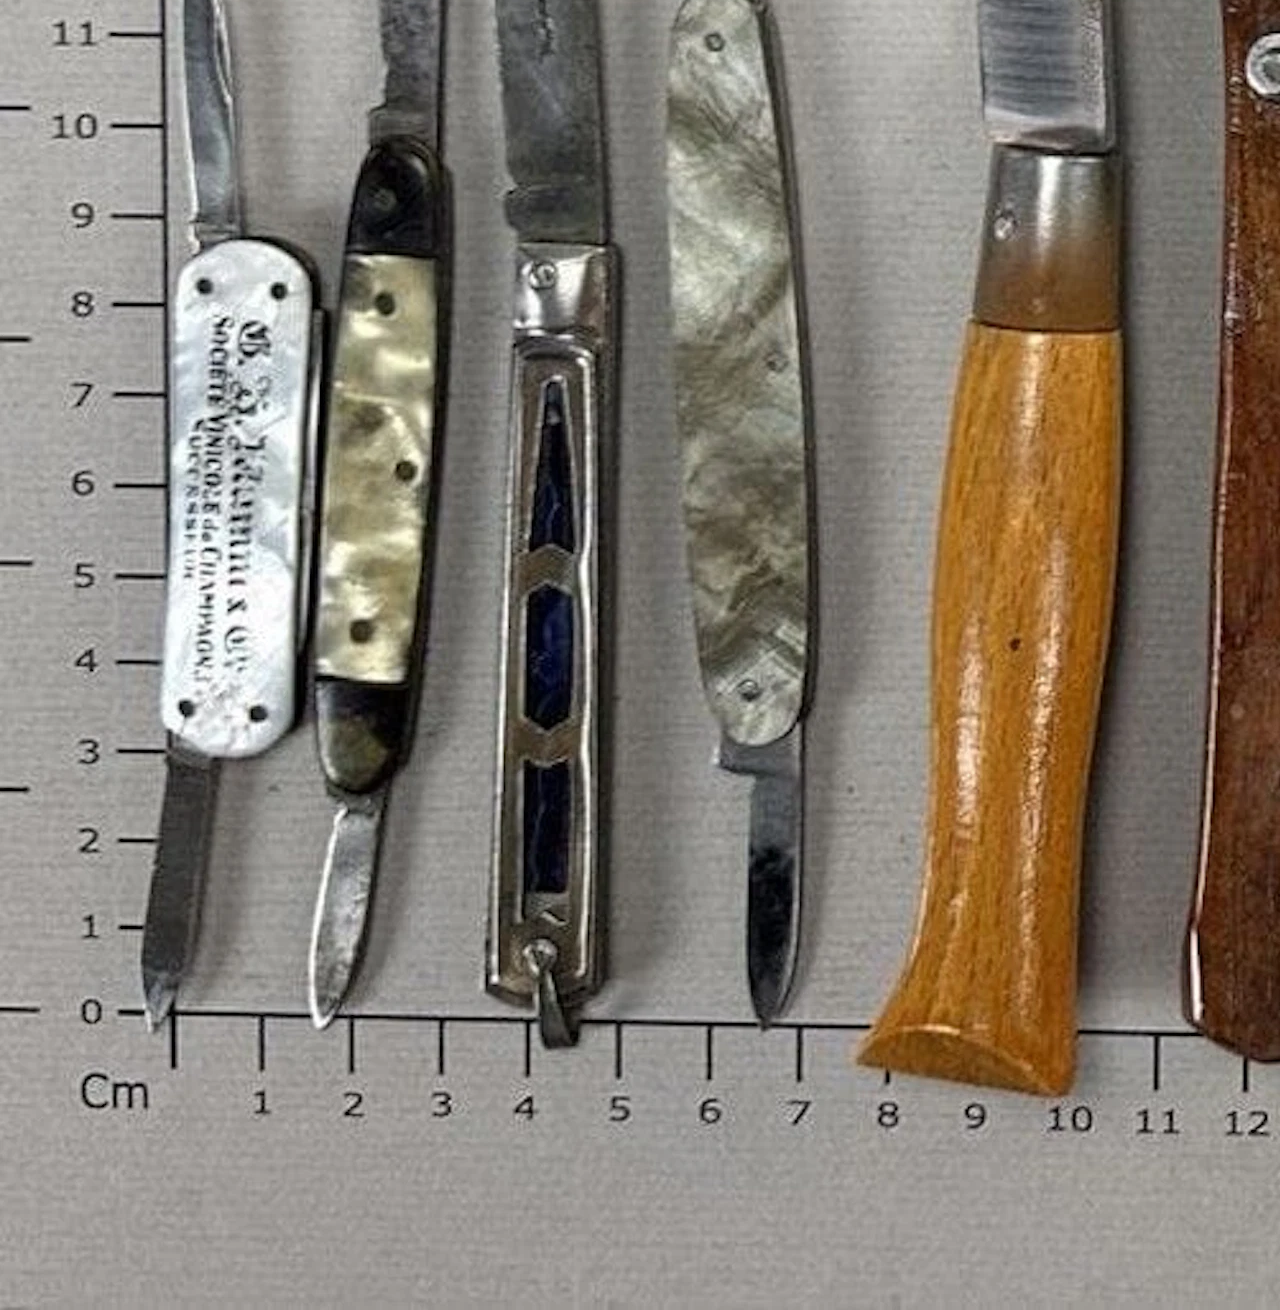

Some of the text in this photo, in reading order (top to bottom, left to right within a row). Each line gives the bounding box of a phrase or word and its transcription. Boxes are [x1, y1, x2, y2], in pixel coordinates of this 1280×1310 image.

[53, 21, 97, 47] 11
[52, 113, 98, 140] 10
[71, 202, 95, 229] 9
[70, 291, 95, 319] 8
[70, 382, 94, 408] 7
[71, 469, 95, 497] 6
[73, 562, 96, 589] 5
[74, 647, 99, 673] 4
[77, 738, 101, 766] 3
[78, 827, 101, 854] 2
[81, 913, 100, 940] 1
[79, 998, 103, 1025] 0
[80, 1072, 150, 1111] Cm
[253, 1089, 272, 1116] 1
[343, 1091, 365, 1119] 2
[431, 1091, 453, 1119] 3
[512, 1095, 539, 1122] 4
[608, 1095, 632, 1123] 5
[698, 1097, 723, 1127] 6
[786, 1099, 813, 1127] 7
[876, 1101, 900, 1131] 8
[963, 1102, 988, 1130] 9
[1046, 1105, 1095, 1133] 10
[1136, 1107, 1181, 1136] 11
[1225, 1110, 1271, 1138] 12
